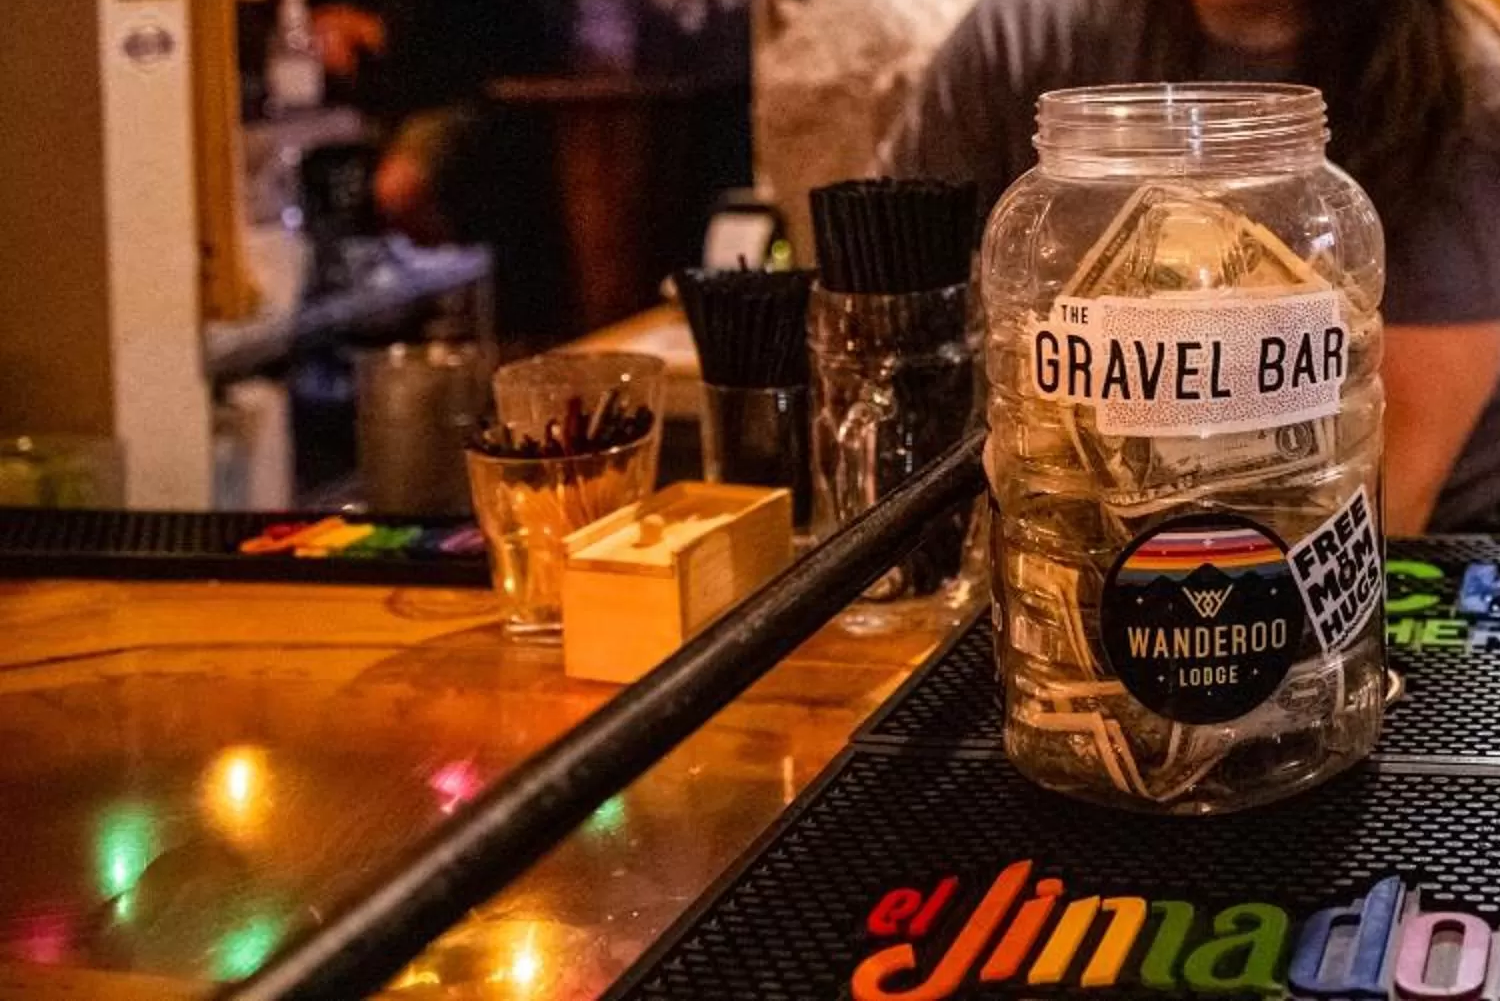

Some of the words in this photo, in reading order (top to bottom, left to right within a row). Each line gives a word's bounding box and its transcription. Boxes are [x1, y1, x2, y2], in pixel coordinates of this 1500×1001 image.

[1060, 304, 1090, 325] THE
[1035, 329, 1231, 400] GRAVEL
[1257, 326, 1344, 394] BAR
[1293, 493, 1367, 582] FREE
[1319, 559, 1379, 645] HUGS
[1127, 618, 1288, 659] WANDEROO
[1178, 664, 1239, 688] LODGE
[867, 875, 958, 938] el
